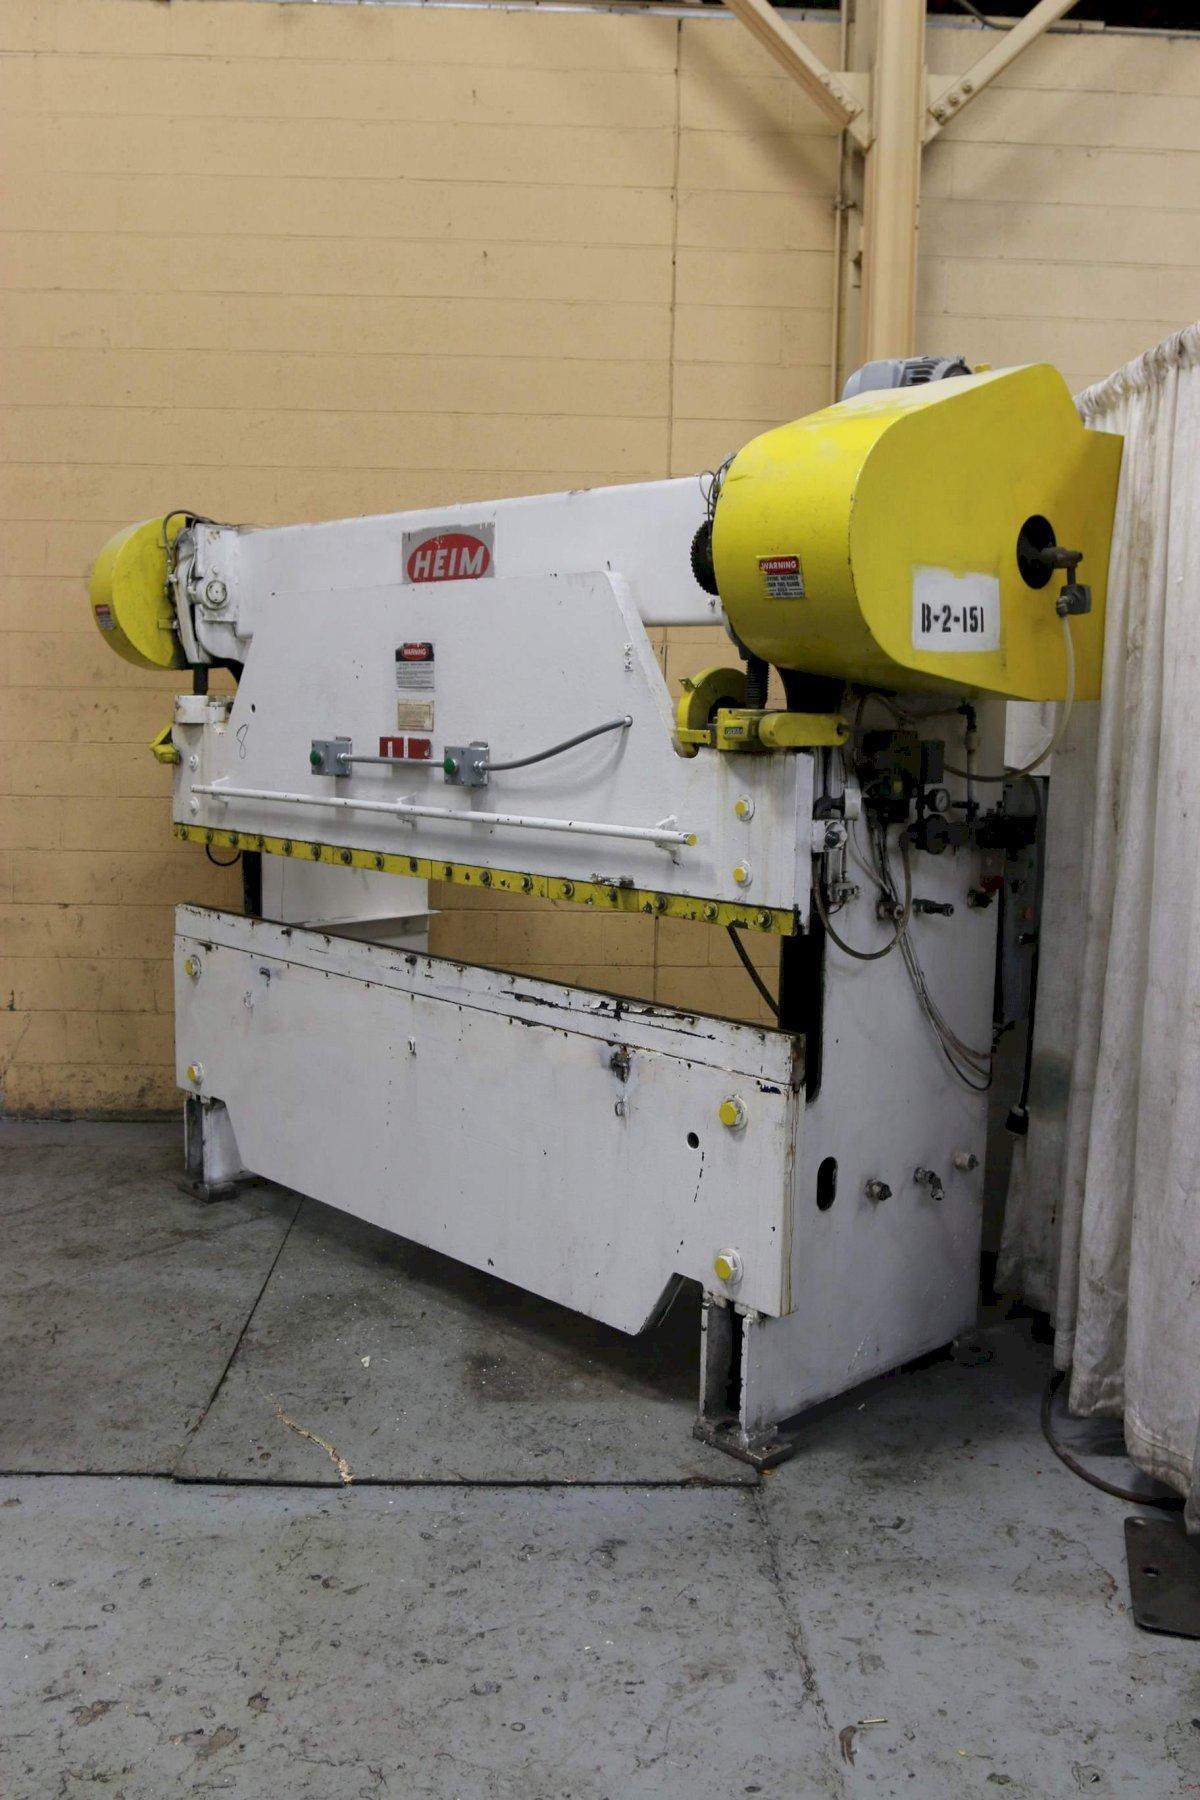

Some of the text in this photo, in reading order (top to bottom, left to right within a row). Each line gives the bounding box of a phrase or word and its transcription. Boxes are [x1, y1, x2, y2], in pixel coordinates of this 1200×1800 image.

[413, 545, 485, 579] HEIM
[761, 561, 797, 570] WARNING
[921, 602, 985, 634] B-2-151
[403, 648, 427, 656] WARNING
